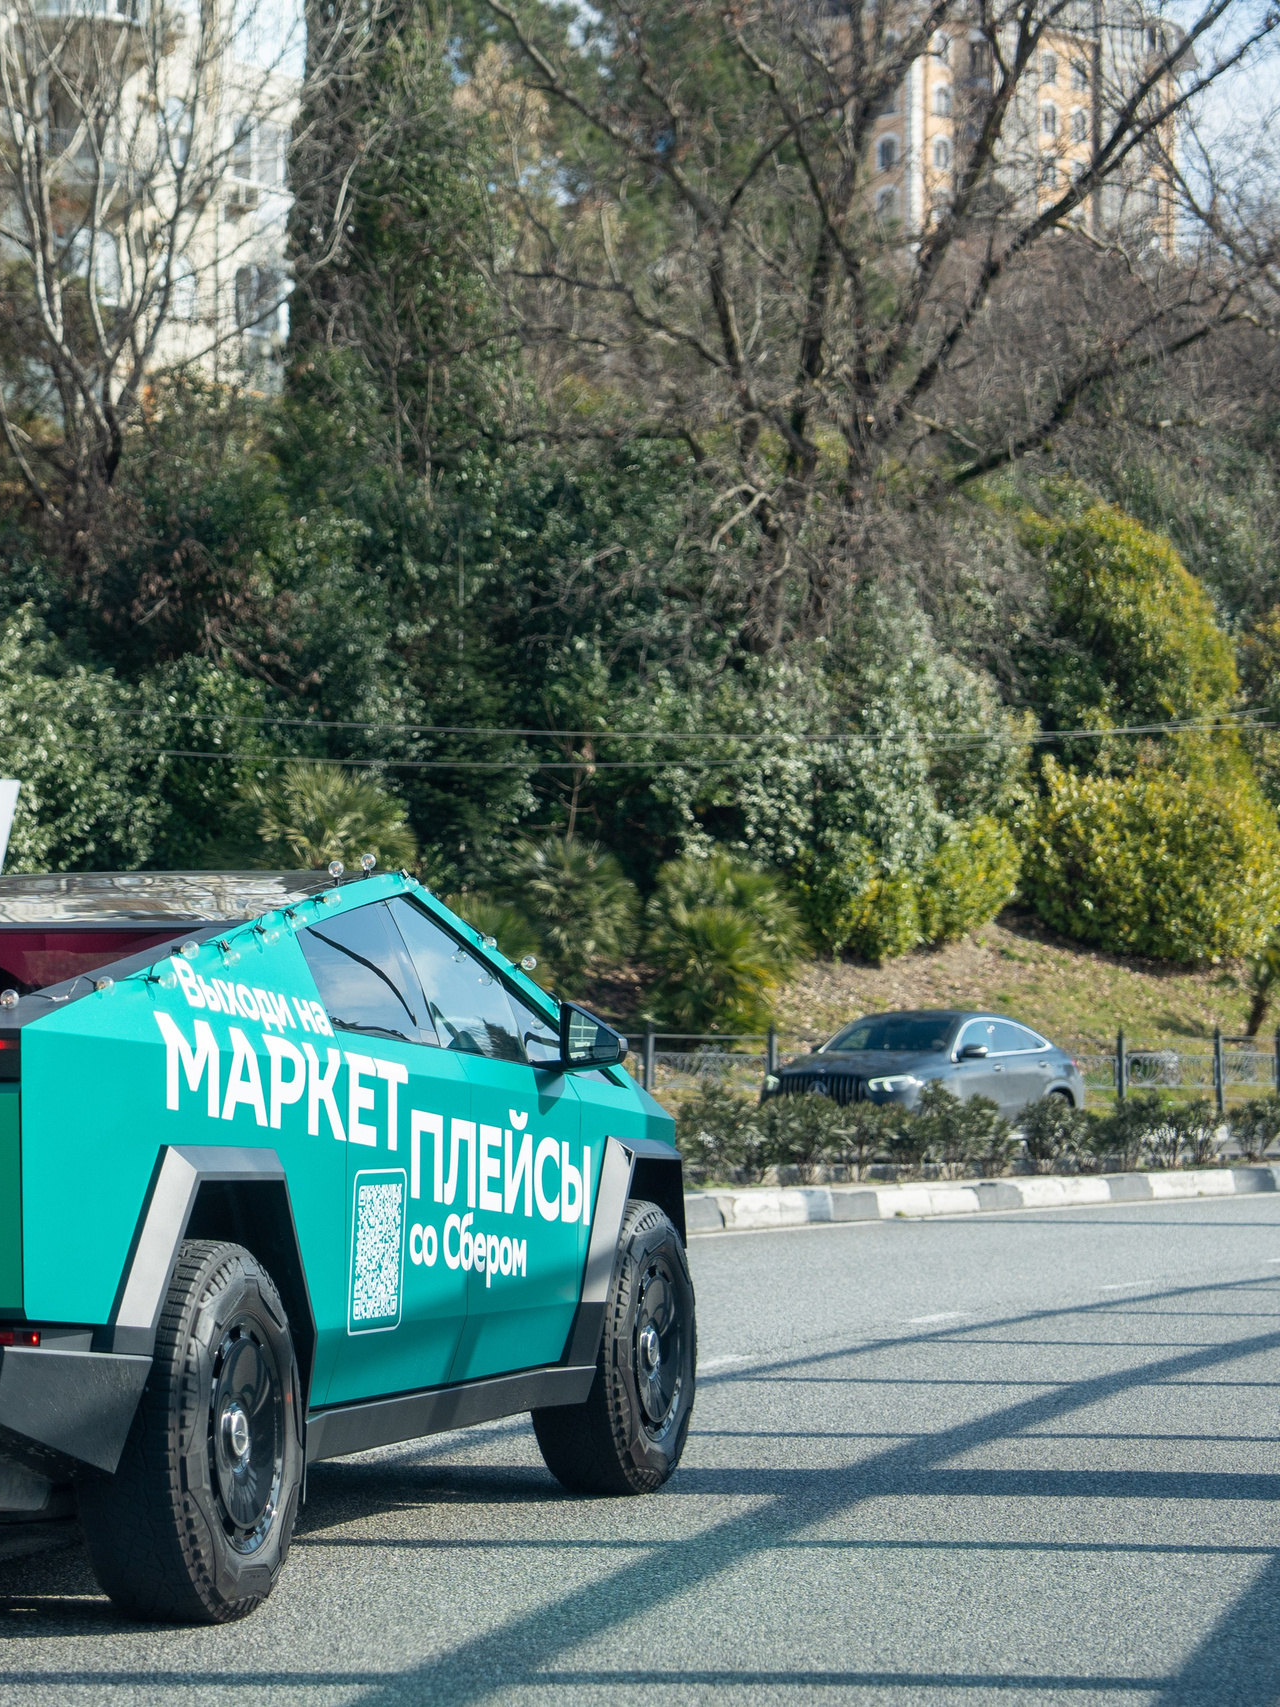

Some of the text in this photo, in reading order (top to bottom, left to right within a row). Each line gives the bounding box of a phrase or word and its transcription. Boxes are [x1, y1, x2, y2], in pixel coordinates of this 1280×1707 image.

[173, 956, 334, 1037] Выходи на
[154, 1010, 409, 1151] МАРКЕТ
[410, 1109, 591, 1226] ПЛЕЙСЫ
[409, 1213, 528, 1288] со Сбером
